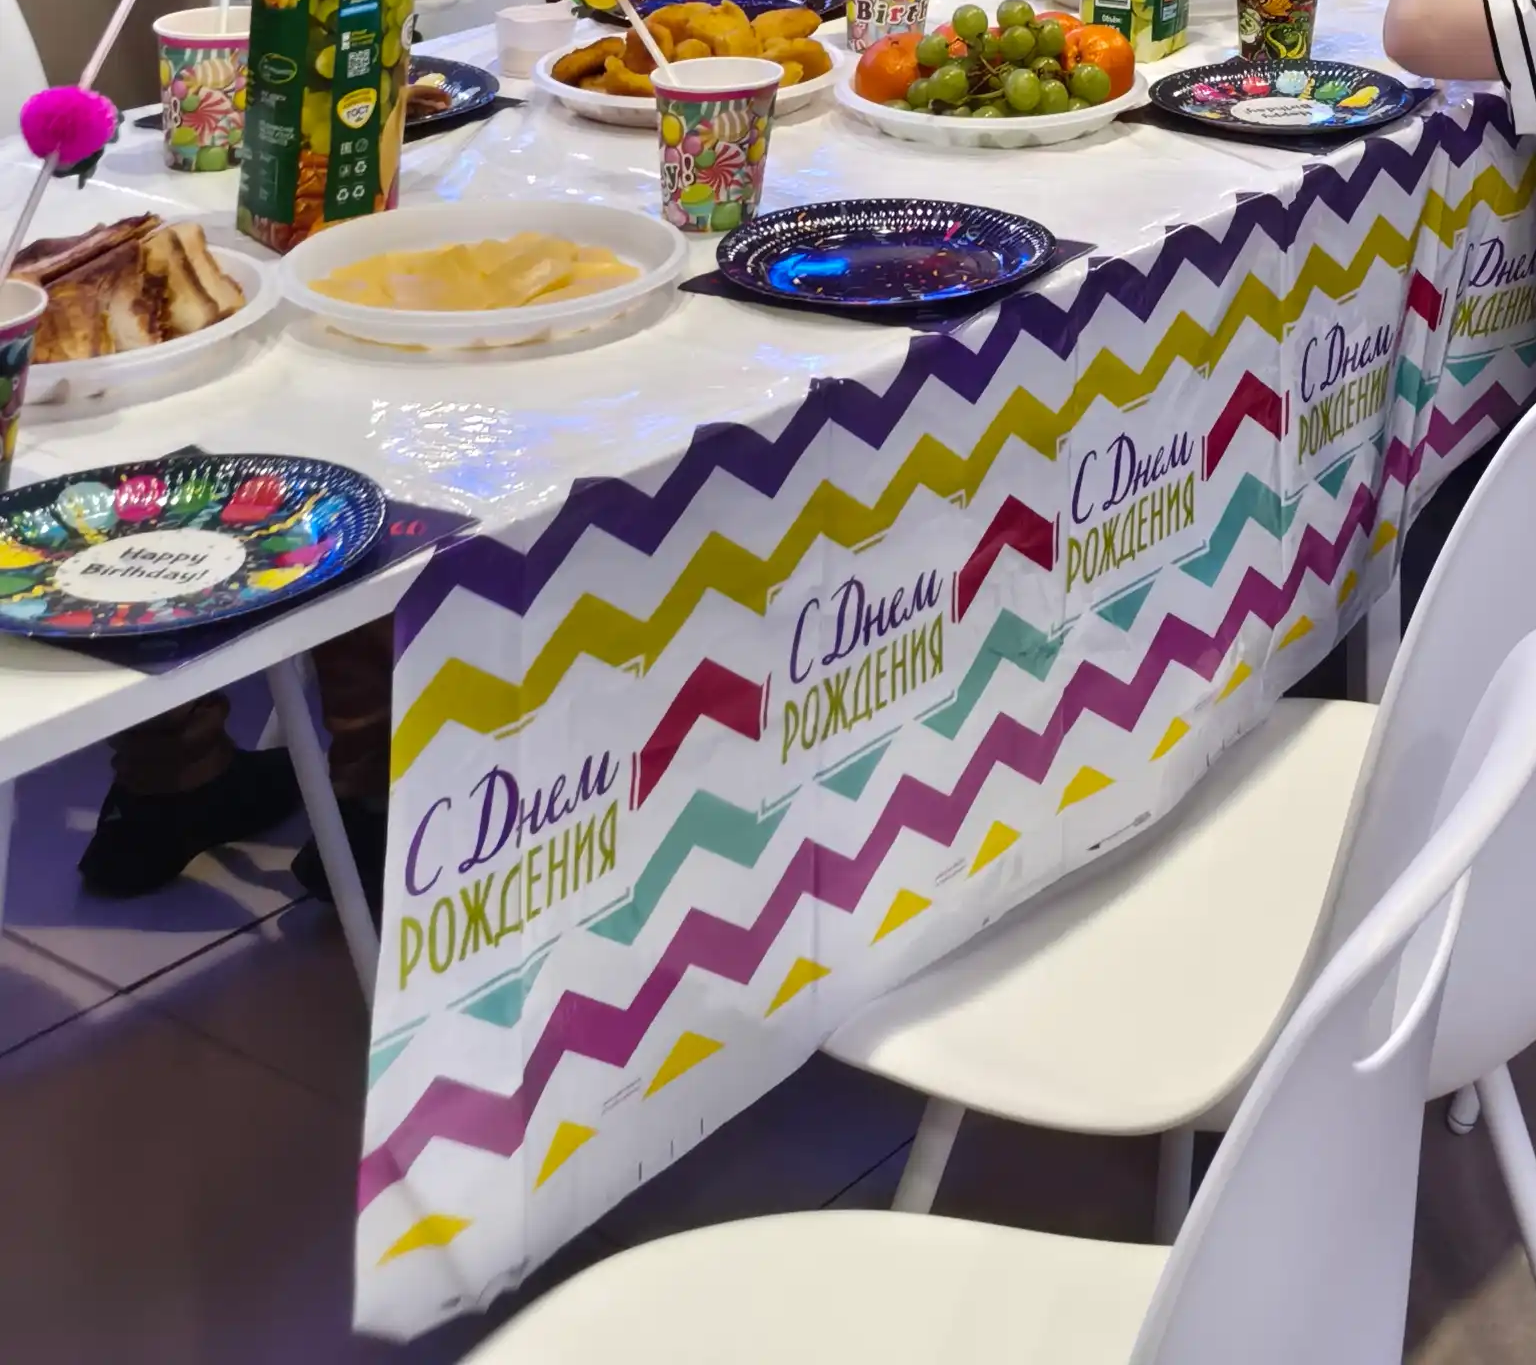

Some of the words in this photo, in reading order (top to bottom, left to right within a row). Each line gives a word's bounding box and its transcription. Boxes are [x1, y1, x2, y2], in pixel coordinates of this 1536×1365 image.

[1301, 336, 1318, 403] С
[1320, 322, 1394, 391] Днем
[1066, 470, 1195, 594] РОЖДЕНИЯ
[1071, 449, 1098, 525] С
[1102, 431, 1195, 512] Днем
[79, 563, 211, 585] Birthday!
[119, 545, 210, 565] Happy
[789, 597, 820, 685] С
[821, 568, 944, 666] Днем
[781, 610, 944, 765] РОЖДЕНИЯ
[404, 796, 452, 897] С
[457, 749, 620, 874] Днем
[399, 798, 618, 991] РОЖДЕНИЯ
